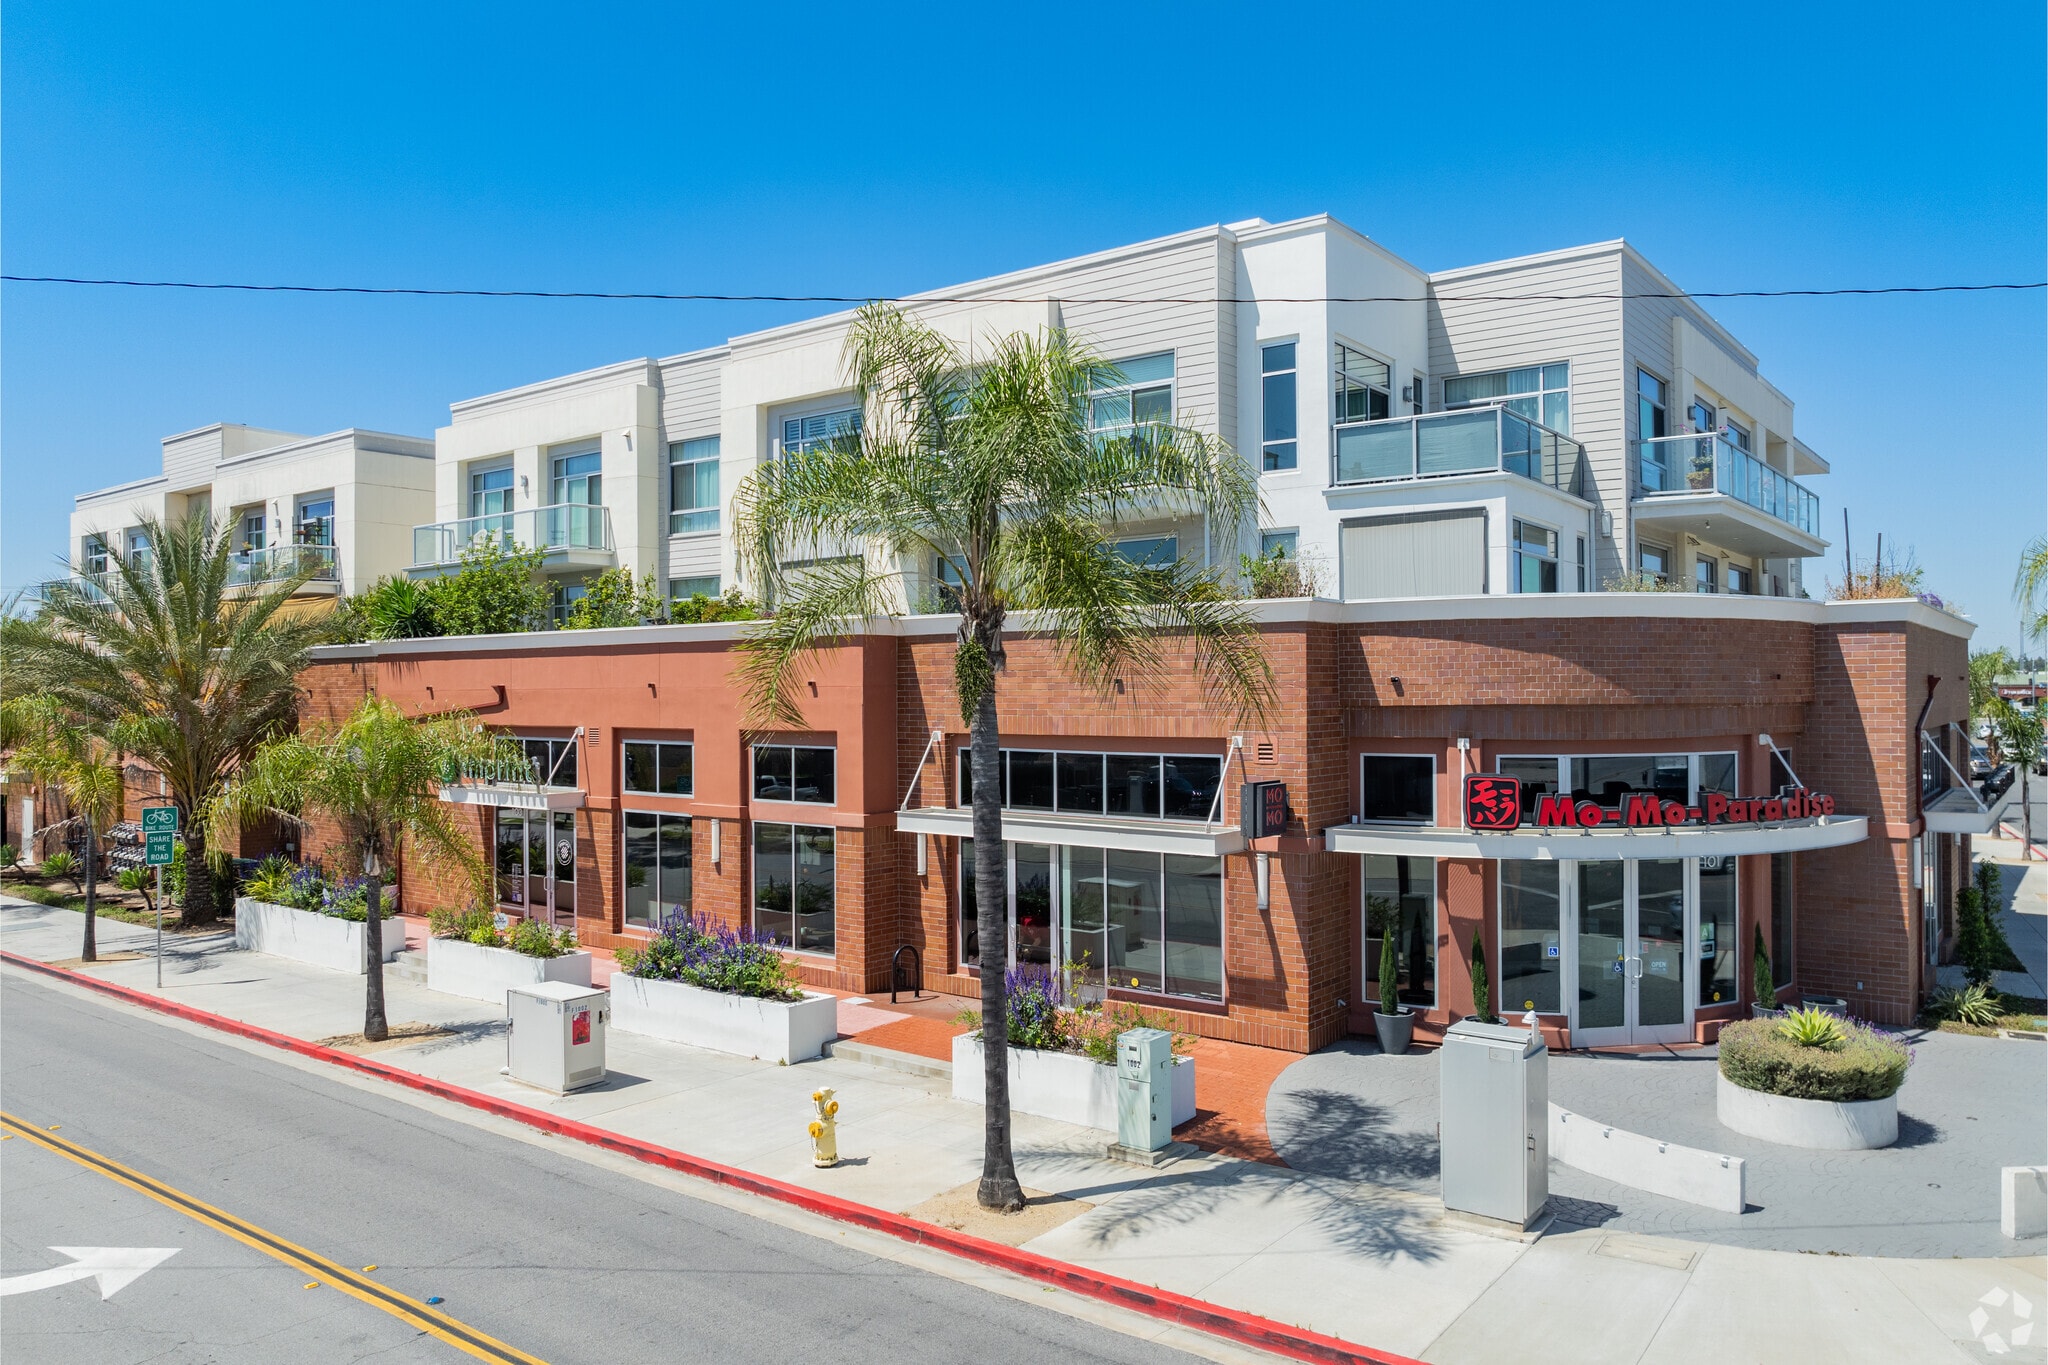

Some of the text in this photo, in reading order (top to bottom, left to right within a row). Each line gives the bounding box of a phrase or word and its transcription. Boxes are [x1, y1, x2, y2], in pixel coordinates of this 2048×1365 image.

[1266, 787, 1283, 804] MO
[1266, 810, 1283, 826] MO
[1127, 1059, 1141, 1068] 1002
